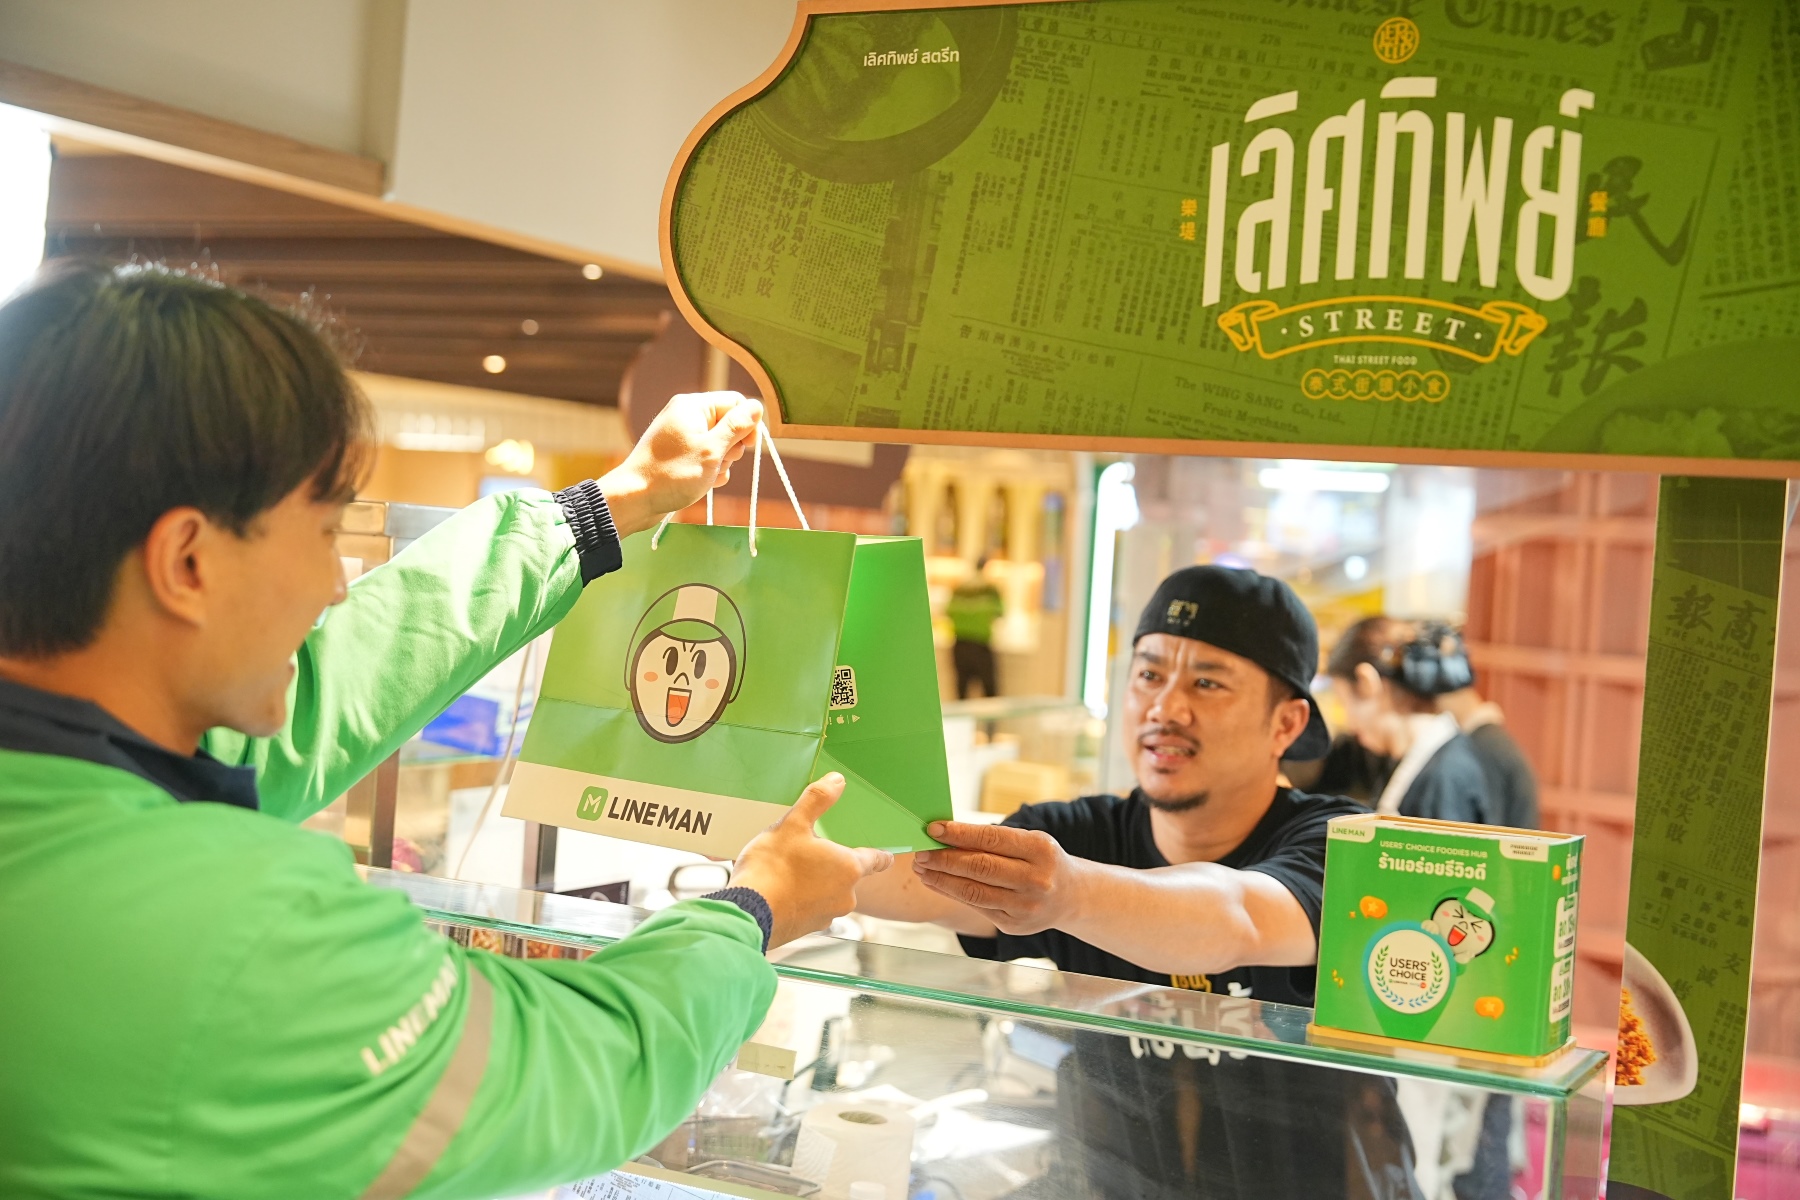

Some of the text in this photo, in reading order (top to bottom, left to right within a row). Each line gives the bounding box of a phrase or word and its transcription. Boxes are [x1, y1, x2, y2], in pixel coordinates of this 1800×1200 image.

[1202, 77, 1596, 308] เลิศทิพย์
[1298, 308, 1467, 342] STREET
[1333, 354, 1356, 365] THAI
[1357, 354, 1390, 366] STREET
[607, 796, 713, 836] LINEMAN
[1331, 826, 1366, 838] LINEMAN
[1405, 842, 1435, 854] CHOICE
[1435, 845, 1471, 858] FOODIES
[1471, 849, 1489, 860] HUB
[1389, 969, 1427, 982] CHOICE
